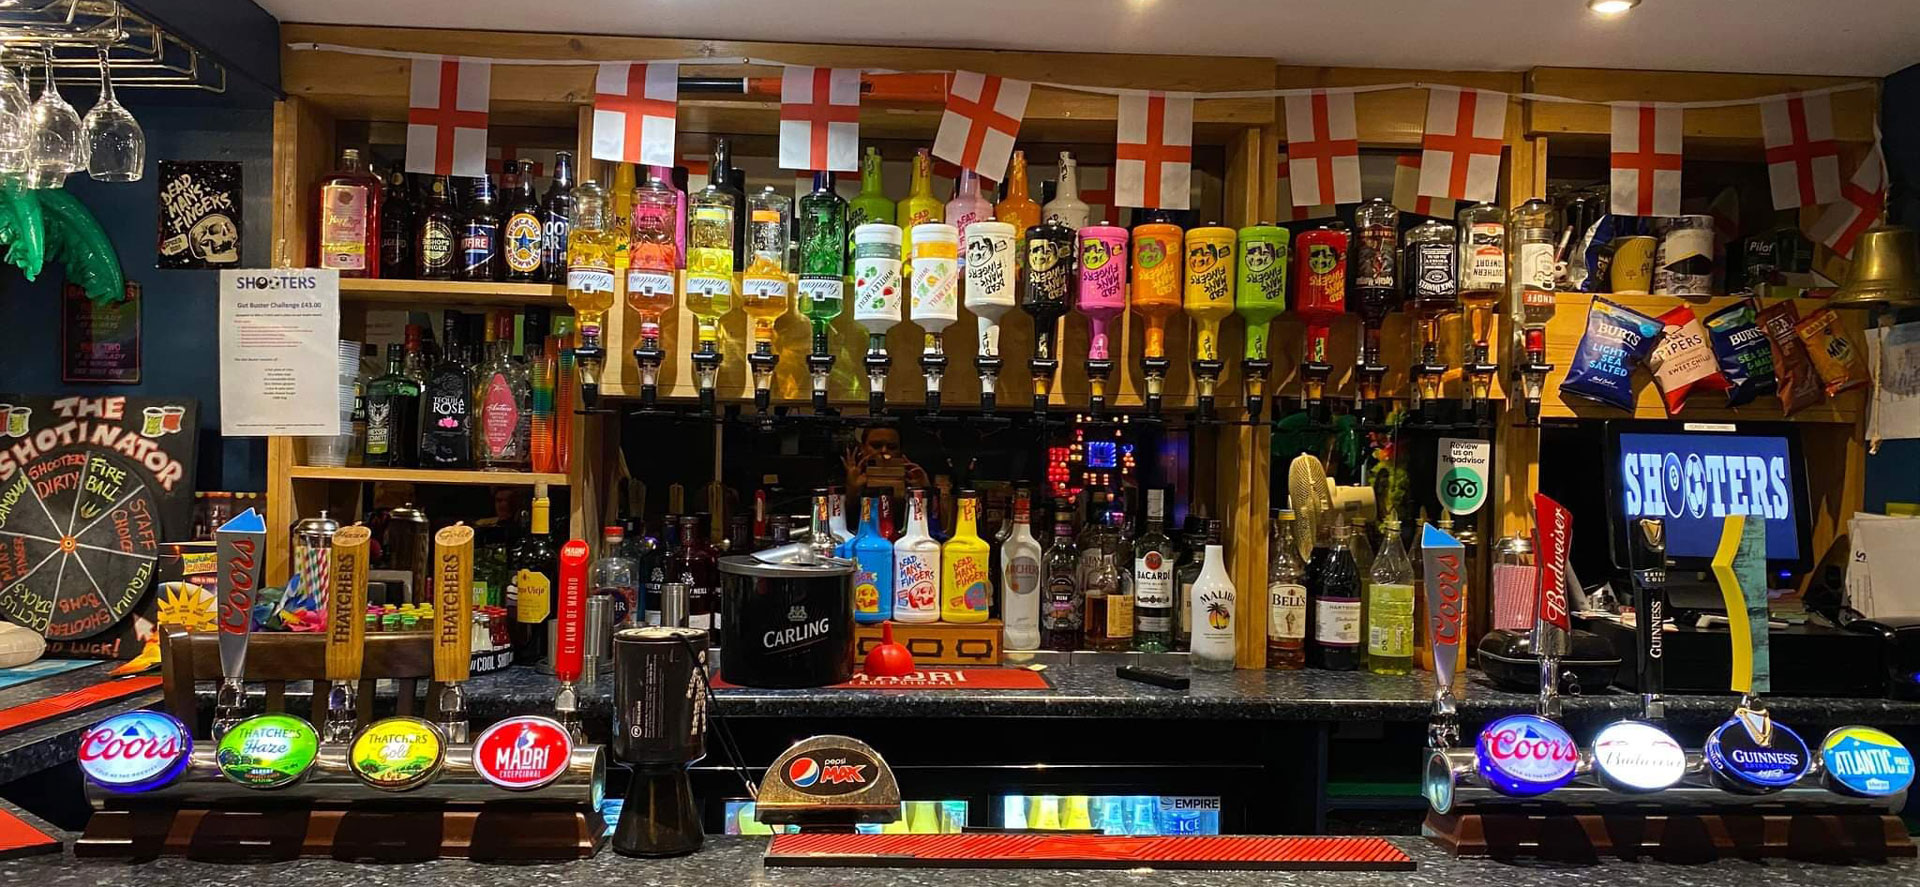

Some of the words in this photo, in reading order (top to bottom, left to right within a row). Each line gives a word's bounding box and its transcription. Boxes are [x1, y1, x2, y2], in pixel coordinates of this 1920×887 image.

[161, 174, 191, 206] DEAD
[168, 184, 203, 219] MAN'S
[173, 192, 235, 234] FINGERS
[909, 209, 930, 226] DEAD
[957, 212, 977, 228] DEAD
[508, 218, 541, 238] NEWCASTLE
[507, 246, 532, 267] BROWN
[968, 260, 1003, 279] FINGERS
[1083, 263, 1119, 281] FINGERS
[1190, 265, 1226, 285] FINGERS
[1246, 265, 1283, 284] FINGERS
[236, 276, 316, 290] SHOOTERS
[871, 270, 894, 294] WHITLEY
[984, 279, 1006, 295] DEAD
[1101, 282, 1120, 297] DEAD
[857, 291, 872, 309] NEILL
[1209, 285, 1228, 300] DEAD
[1266, 285, 1283, 300] DEAD
[1527, 293, 1555, 304] RNOFF
[237, 302, 248, 310] Gut
[270, 302, 300, 310] Challenge
[1597, 322, 1642, 348] BURTS
[1728, 326, 1763, 346] BURTS
[1593, 343, 1630, 358] LIGHT
[1657, 334, 1702, 361] PIPERS
[1589, 360, 1628, 377] SALTED
[1600, 354, 1622, 367] SEA
[1668, 362, 1692, 376] SWEET
[52, 396, 127, 421] THE
[432, 395, 465, 406] TEQUILA
[432, 402, 466, 414] ROSE
[1450, 441, 1478, 451] Review
[0, 422, 183, 492] SHOTINATOR
[28, 453, 88, 480] SHOOTERS
[1442, 456, 1486, 465] Tripadvisor
[90, 457, 127, 485] FIRE
[37, 472, 81, 499] DIRTY
[85, 476, 123, 502] BALL
[1623, 451, 1789, 520] SHOOTERS
[111, 509, 134, 553] CHOICE
[129, 498, 156, 550] STAFF
[900, 555, 917, 568] DEAD
[900, 563, 922, 579] MAN'S
[953, 557, 972, 571] DEAD
[1546, 506, 1571, 622] Budweiser
[113, 560, 155, 615] TEQUILA
[219, 538, 257, 637] Coors
[901, 571, 935, 587] FINGERS
[955, 571, 989, 588] FINGERS
[14, 583, 52, 614] JACK'S
[332, 552, 356, 646] THATCHERS
[440, 553, 461, 648] THATCHERS
[566, 577, 579, 607] MADRID
[1272, 594, 1306, 607] BELL'S
[1434, 553, 1460, 645] Coors
[59, 592, 100, 612] BOMB
[0, 594, 49, 634] CACTUS
[48, 607, 112, 637] SHOOTERS
[566, 608, 578, 619] DE
[565, 621, 577, 642] ALMA
[763, 617, 830, 649] CARLING
[1650, 601, 1662, 658] GUINNESS
[71, 638, 121, 657] LUCK!
[564, 645, 576, 654] EL
[477, 655, 495, 672] COOL
[239, 728, 303, 739] THATCHERS
[368, 734, 428, 745] THATCHERS
[79, 727, 180, 762] Coors
[244, 737, 289, 754] Haze
[376, 744, 411, 764] Gold
[1484, 729, 1580, 762] Coors
[824, 757, 846, 766] pepsi
[1732, 749, 1799, 766] GUINNESS
[1835, 750, 1897, 776] ATLANTIC
[500, 769, 542, 778] EXCEPCIONAL
[820, 764, 867, 785] MAX
[1175, 799, 1219, 809] EMPIRE
[1179, 820, 1201, 831] ICE
